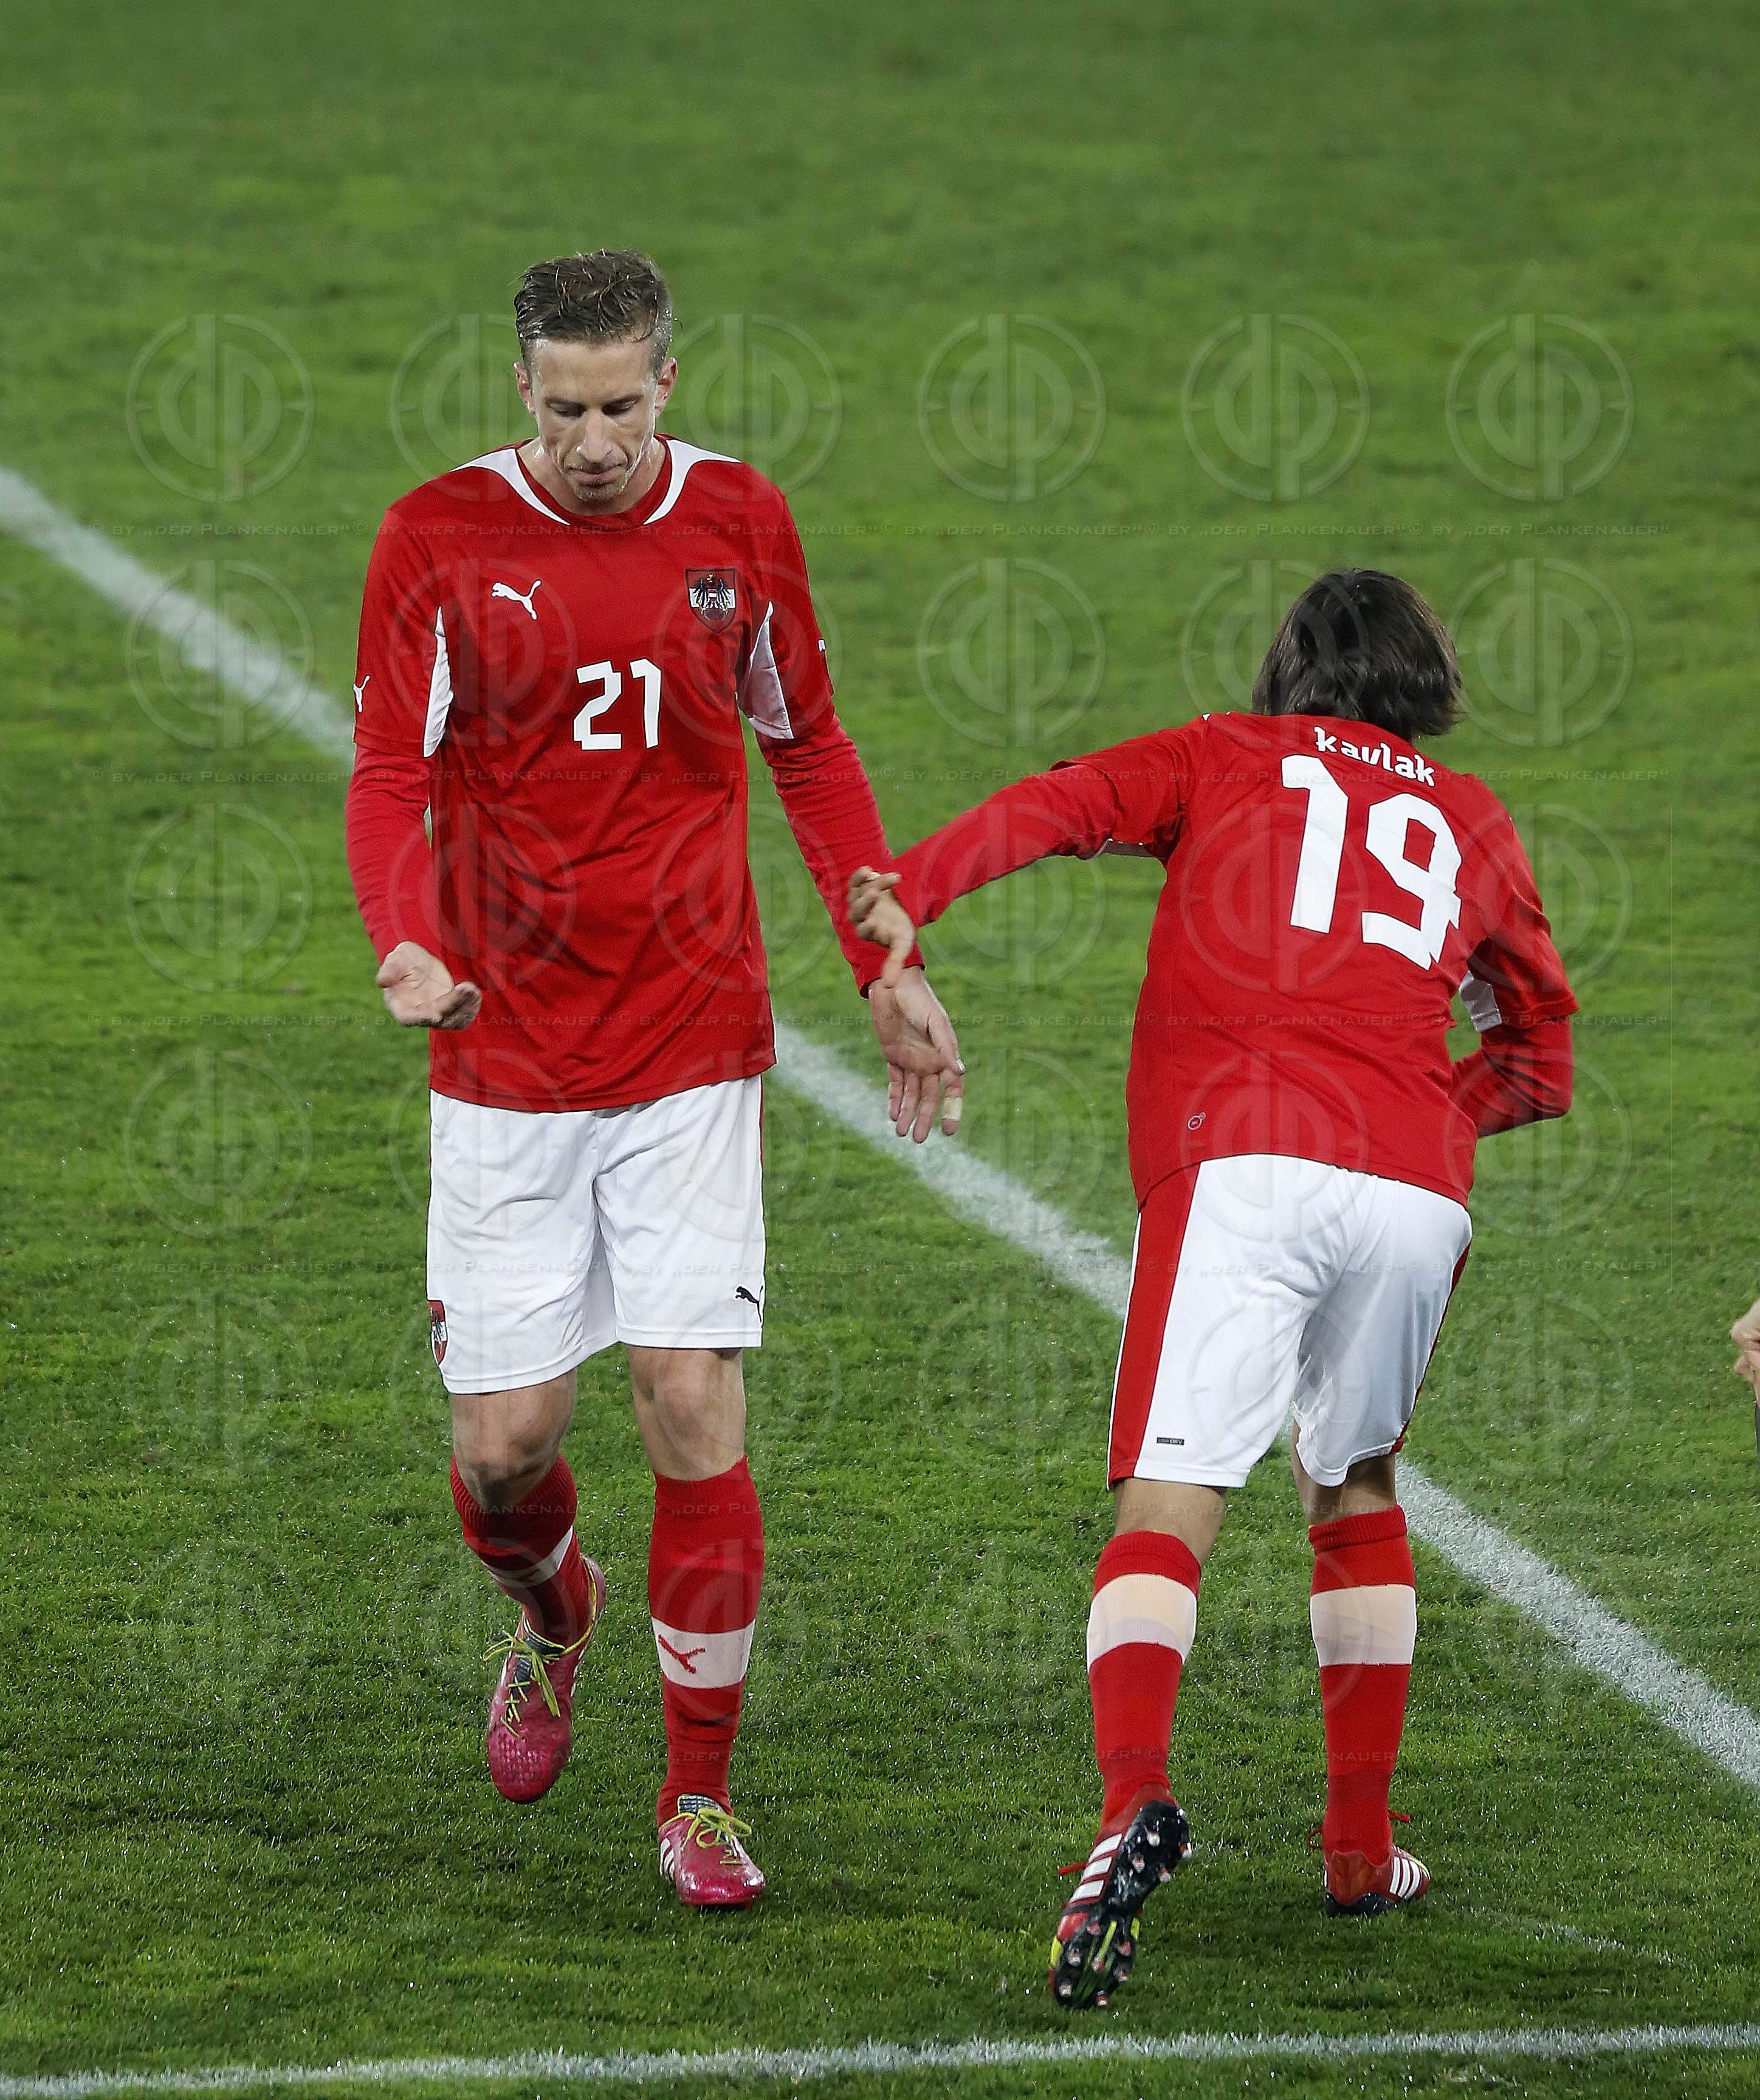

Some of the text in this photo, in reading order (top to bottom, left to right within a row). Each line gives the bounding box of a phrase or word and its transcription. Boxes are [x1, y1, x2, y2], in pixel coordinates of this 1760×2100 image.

[572, 658, 662, 751] 21
[1313, 726, 1436, 787] kavlak
[1280, 753, 1463, 971] 19
